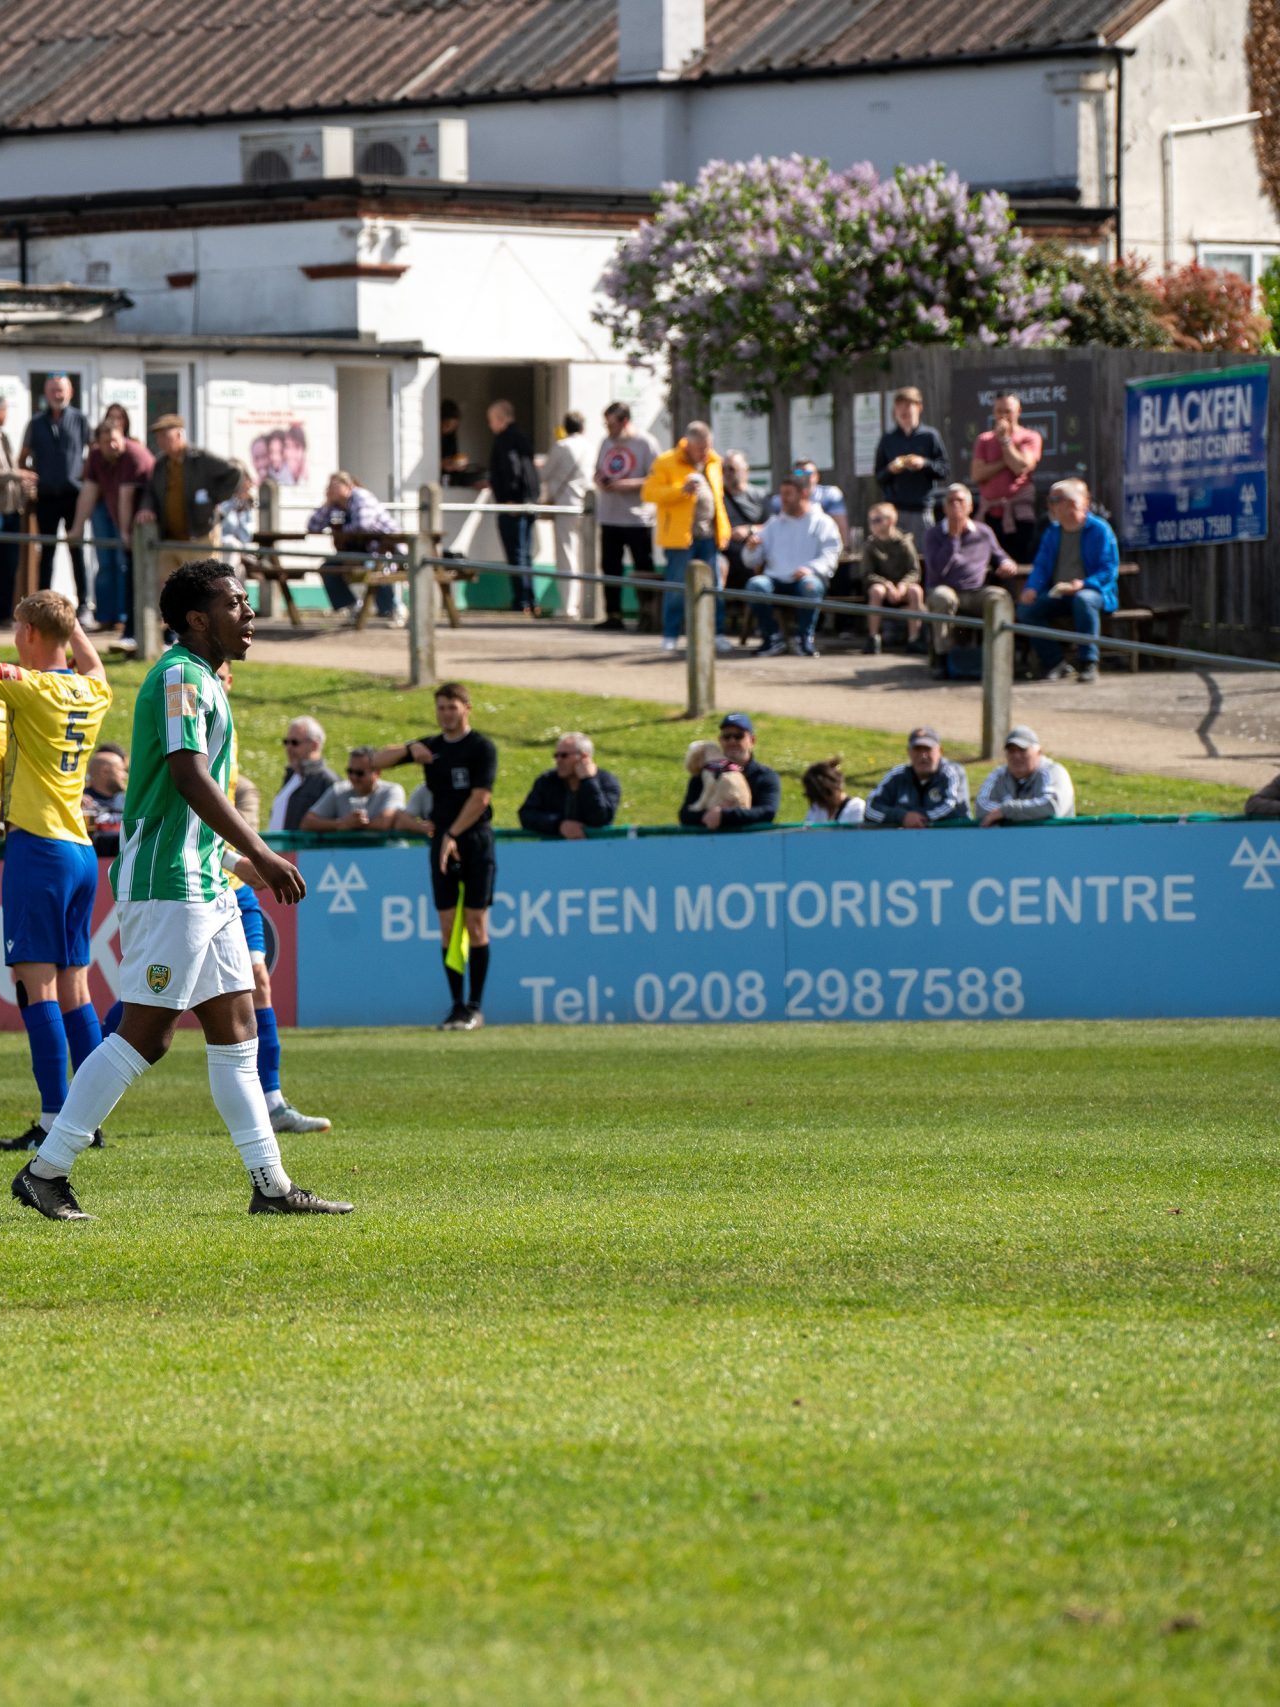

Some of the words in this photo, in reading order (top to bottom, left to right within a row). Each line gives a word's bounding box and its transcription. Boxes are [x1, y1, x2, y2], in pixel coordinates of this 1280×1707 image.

[1053, 385, 1067, 402] FC
[1139, 384, 1253, 438] BLACKFEN
[1138, 436, 1202, 466] MOTORIST
[1205, 431, 1252, 461] CENTRE
[60, 711, 89, 772] 5
[381, 885, 657, 942] BLCKFEN
[674, 878, 954, 933] MOTORIST
[968, 874, 1197, 926] CENTRE
[520, 974, 616, 1023] Tel:
[634, 969, 767, 1021] 0208
[783, 966, 1026, 1018] 2987588
